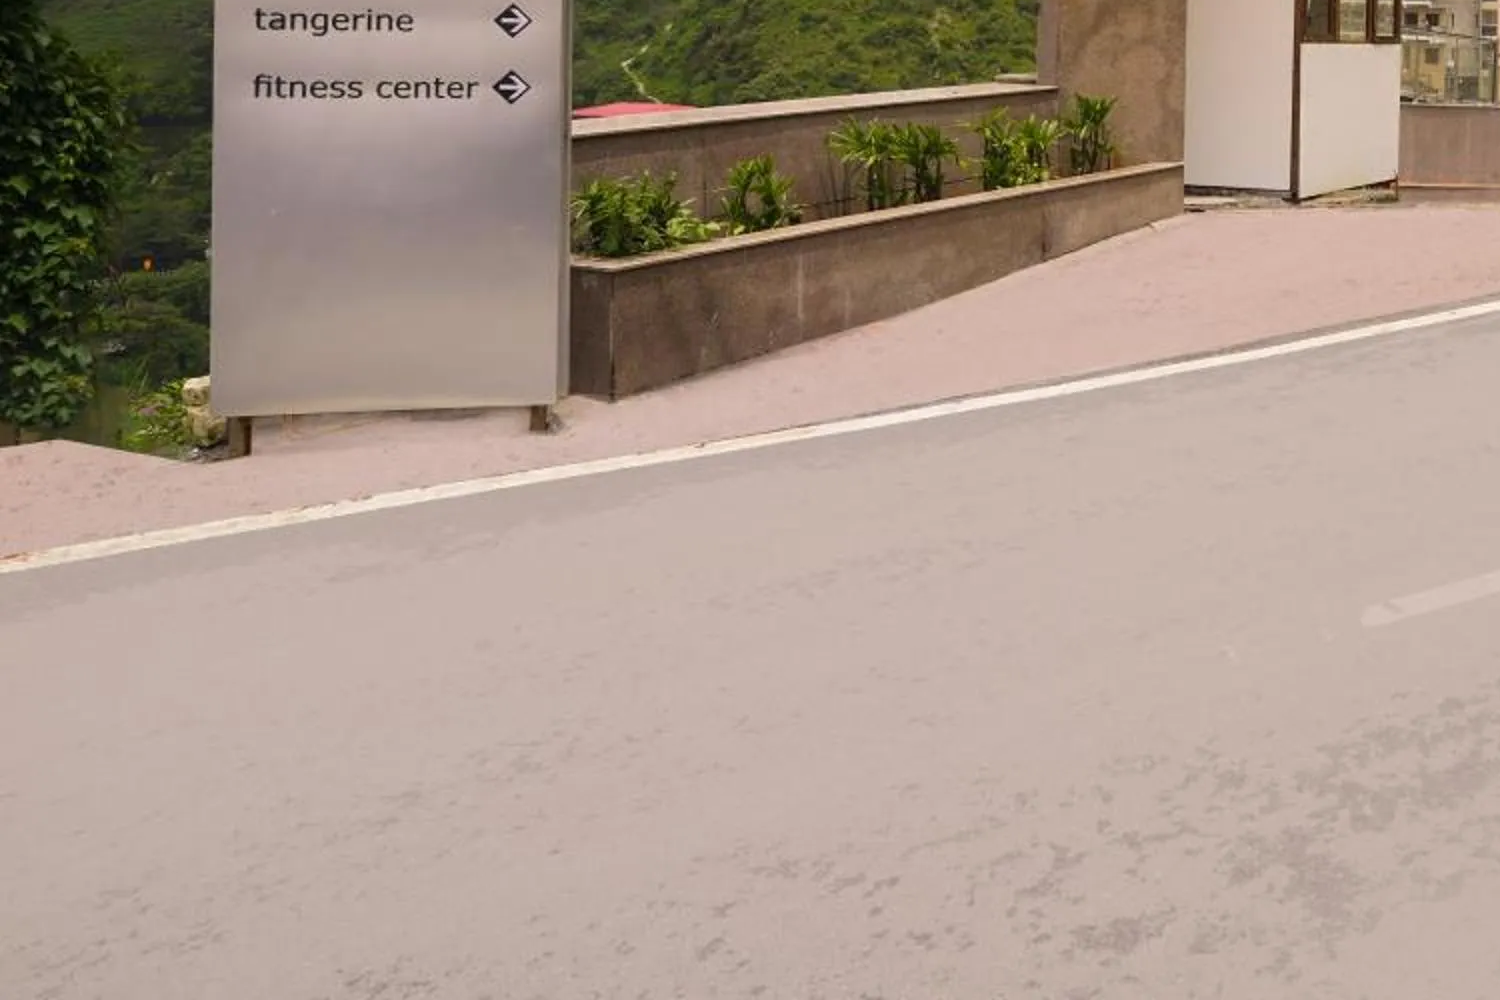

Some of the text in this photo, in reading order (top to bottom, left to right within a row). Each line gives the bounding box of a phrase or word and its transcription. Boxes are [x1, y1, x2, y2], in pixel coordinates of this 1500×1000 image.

[254, 8, 415, 37] tangerine
[252, 73, 479, 100] fitness center
